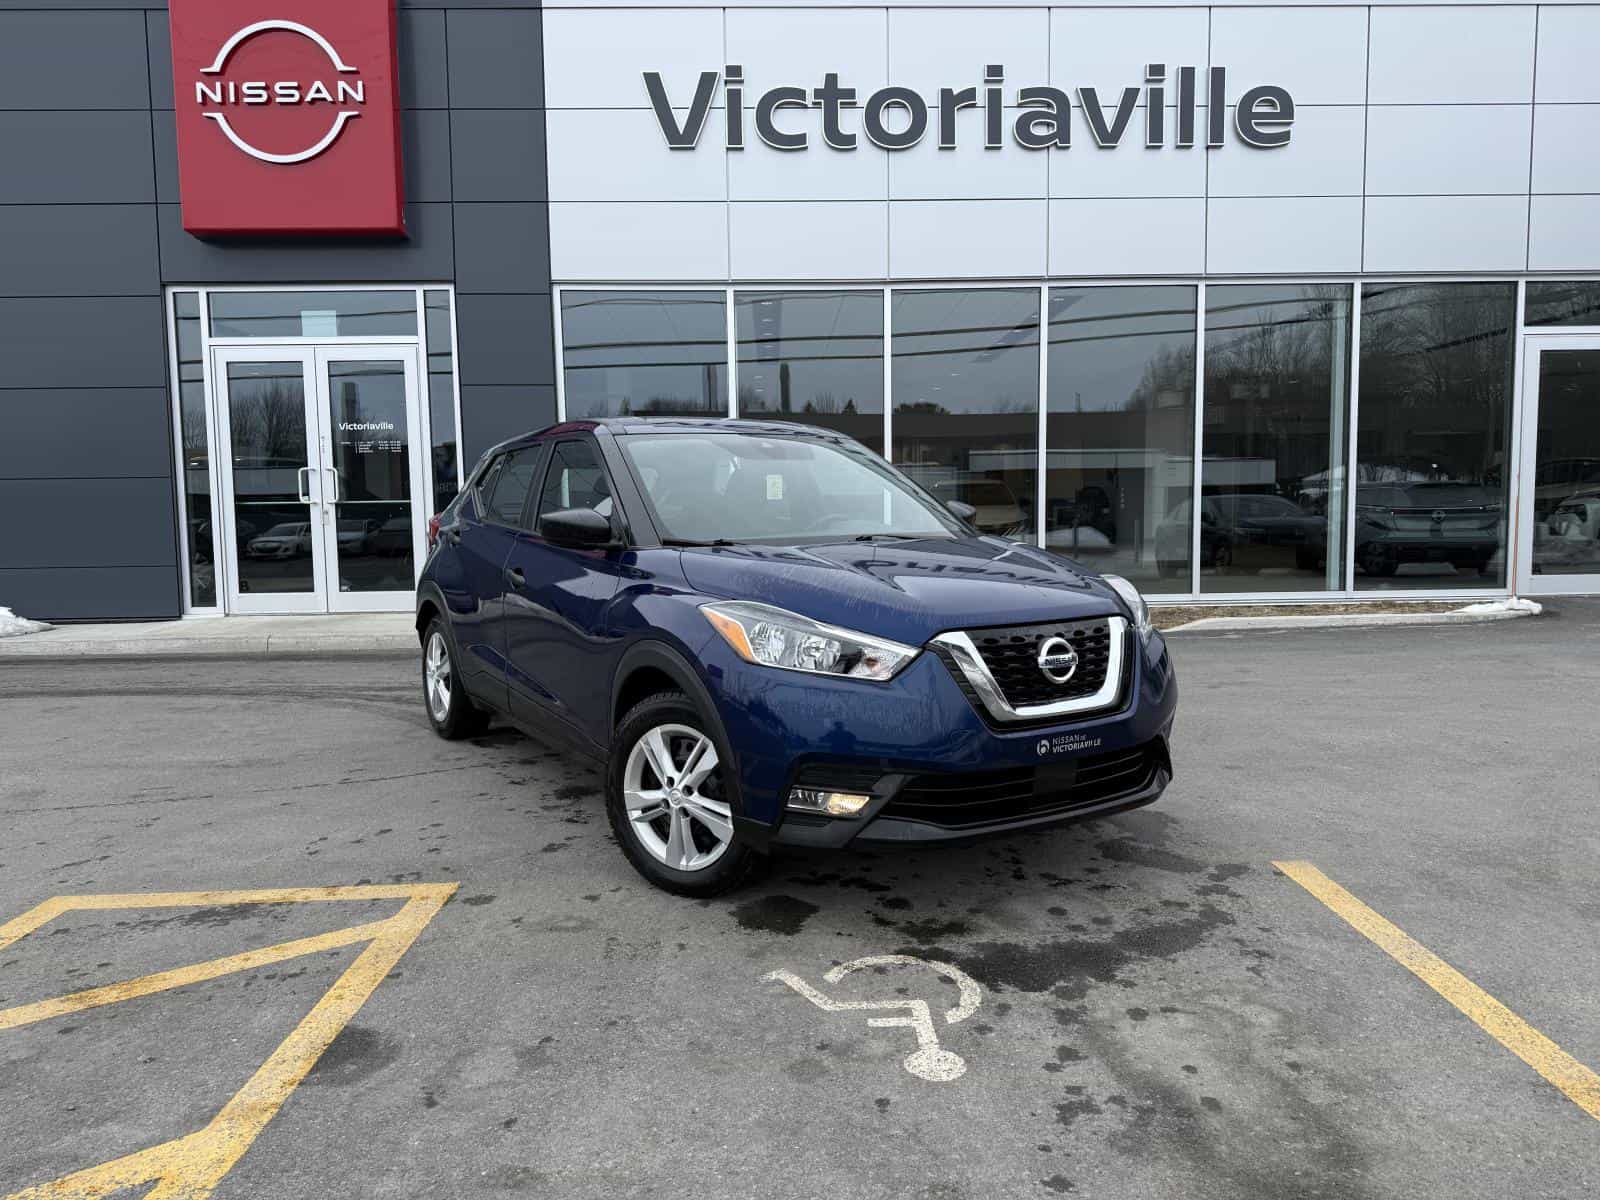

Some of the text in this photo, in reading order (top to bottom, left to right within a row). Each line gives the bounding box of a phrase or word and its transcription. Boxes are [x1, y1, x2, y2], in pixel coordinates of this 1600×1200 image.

[194, 80, 365, 104] NISSAN
[642, 63, 1295, 152] Victoriaville
[338, 422, 394, 431] Victoriaville
[1052, 734, 1080, 745] NISSAN
